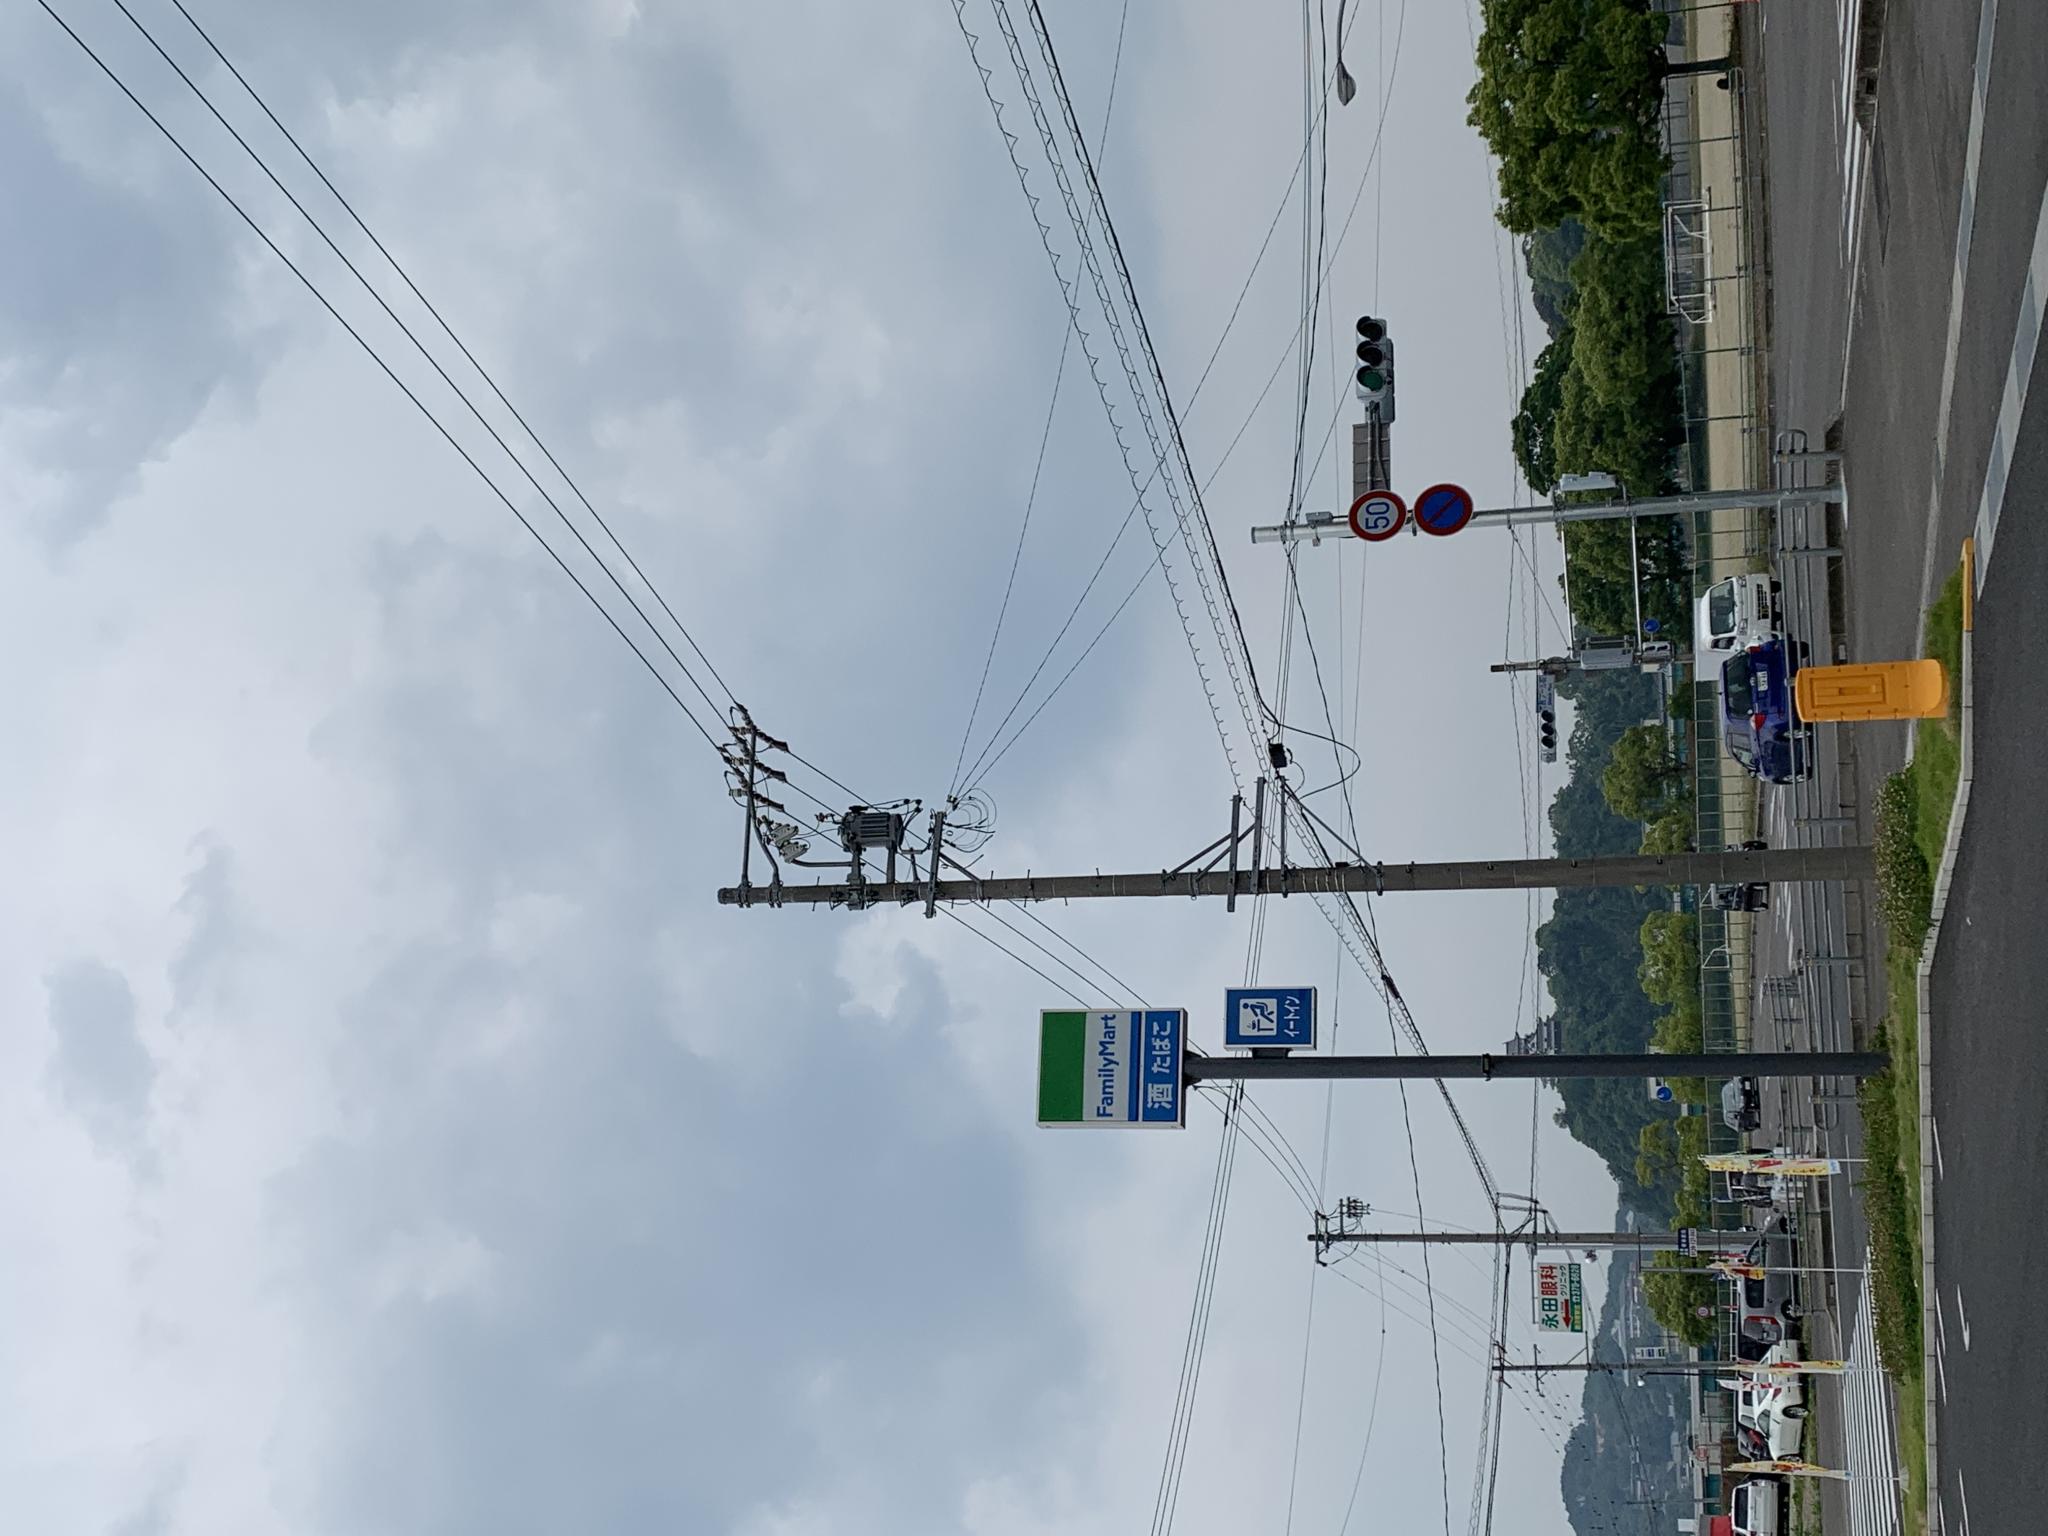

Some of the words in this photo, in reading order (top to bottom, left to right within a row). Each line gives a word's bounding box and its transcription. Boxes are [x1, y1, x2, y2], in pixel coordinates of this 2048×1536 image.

[1365, 502, 1390, 530] 50
[1283, 996, 1300, 1037] イートイン
[1097, 1015, 1119, 1117] FamilyMart
[1151, 1022, 1171, 1074] たばこ
[1147, 1084, 1173, 1109] 酒
[1540, 1265, 1559, 1328] 永田眼科
[1559, 1265, 1568, 1296] クリニック
